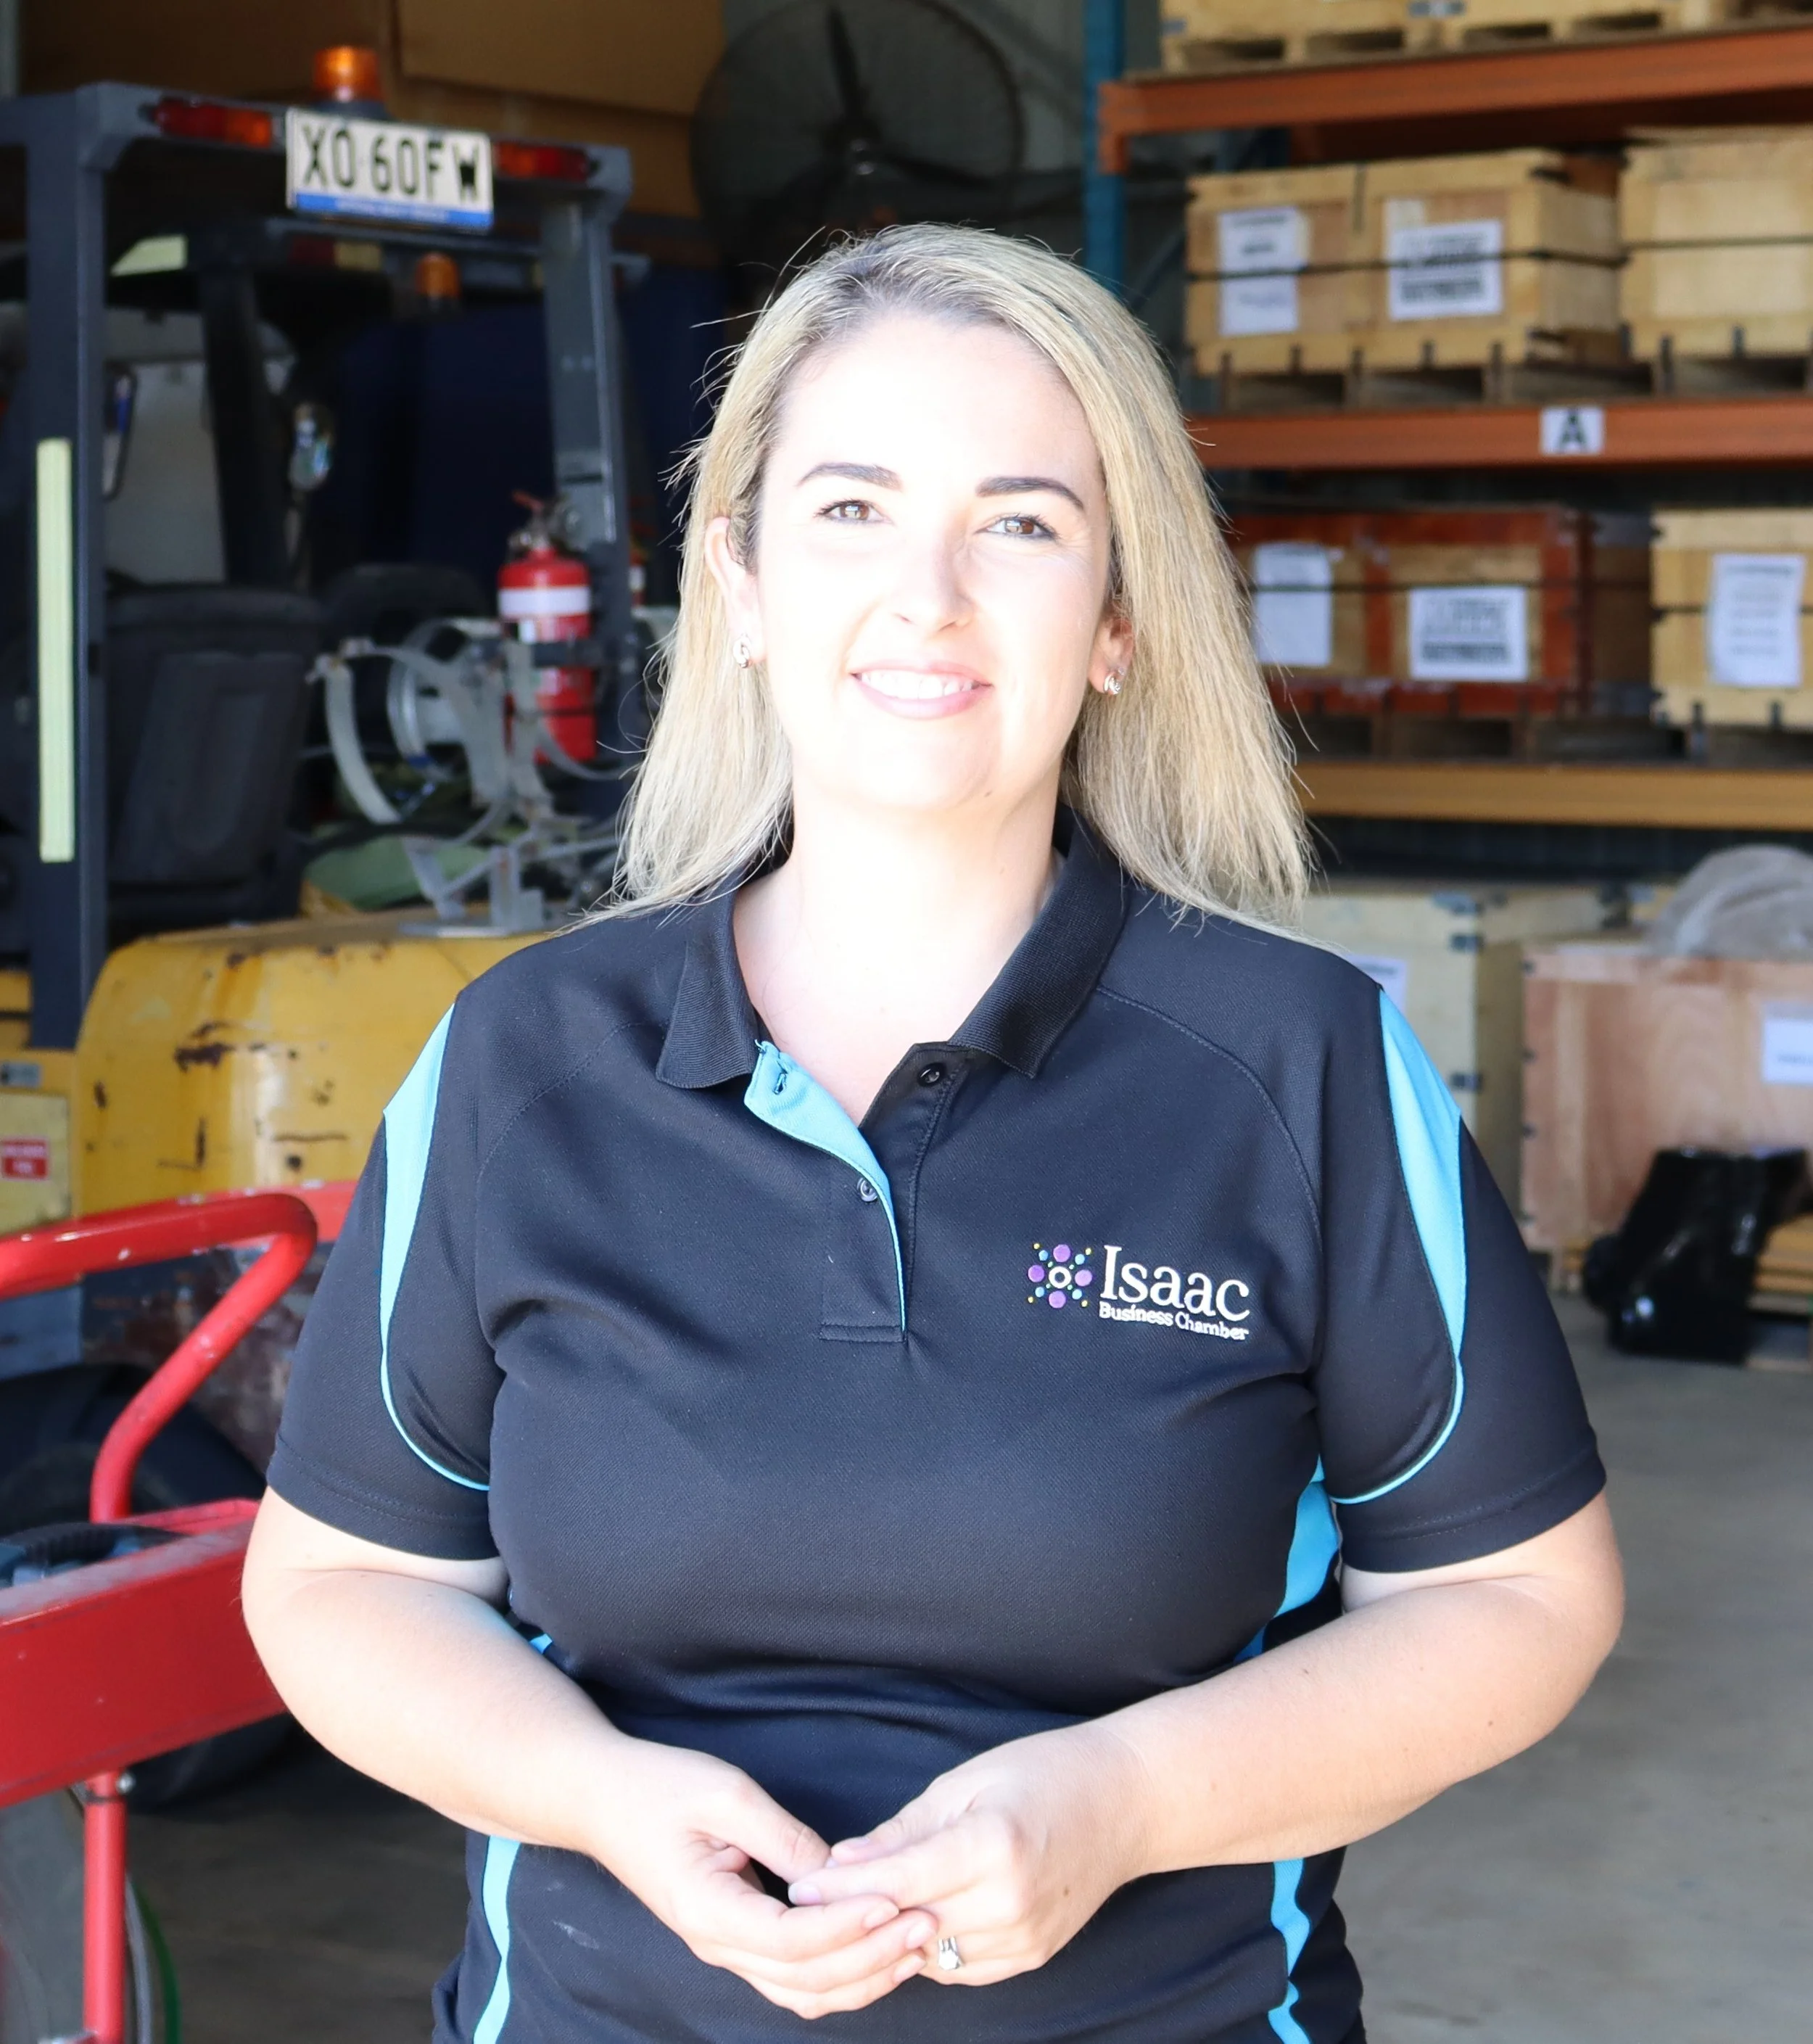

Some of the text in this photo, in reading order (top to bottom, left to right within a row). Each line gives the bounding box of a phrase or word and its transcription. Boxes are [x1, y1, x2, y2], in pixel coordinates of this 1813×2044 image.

[1558, 411, 1588, 453] A
[1099, 1244, 1251, 1322] Isaac
[1099, 1301, 1250, 1341] Business Chamber
